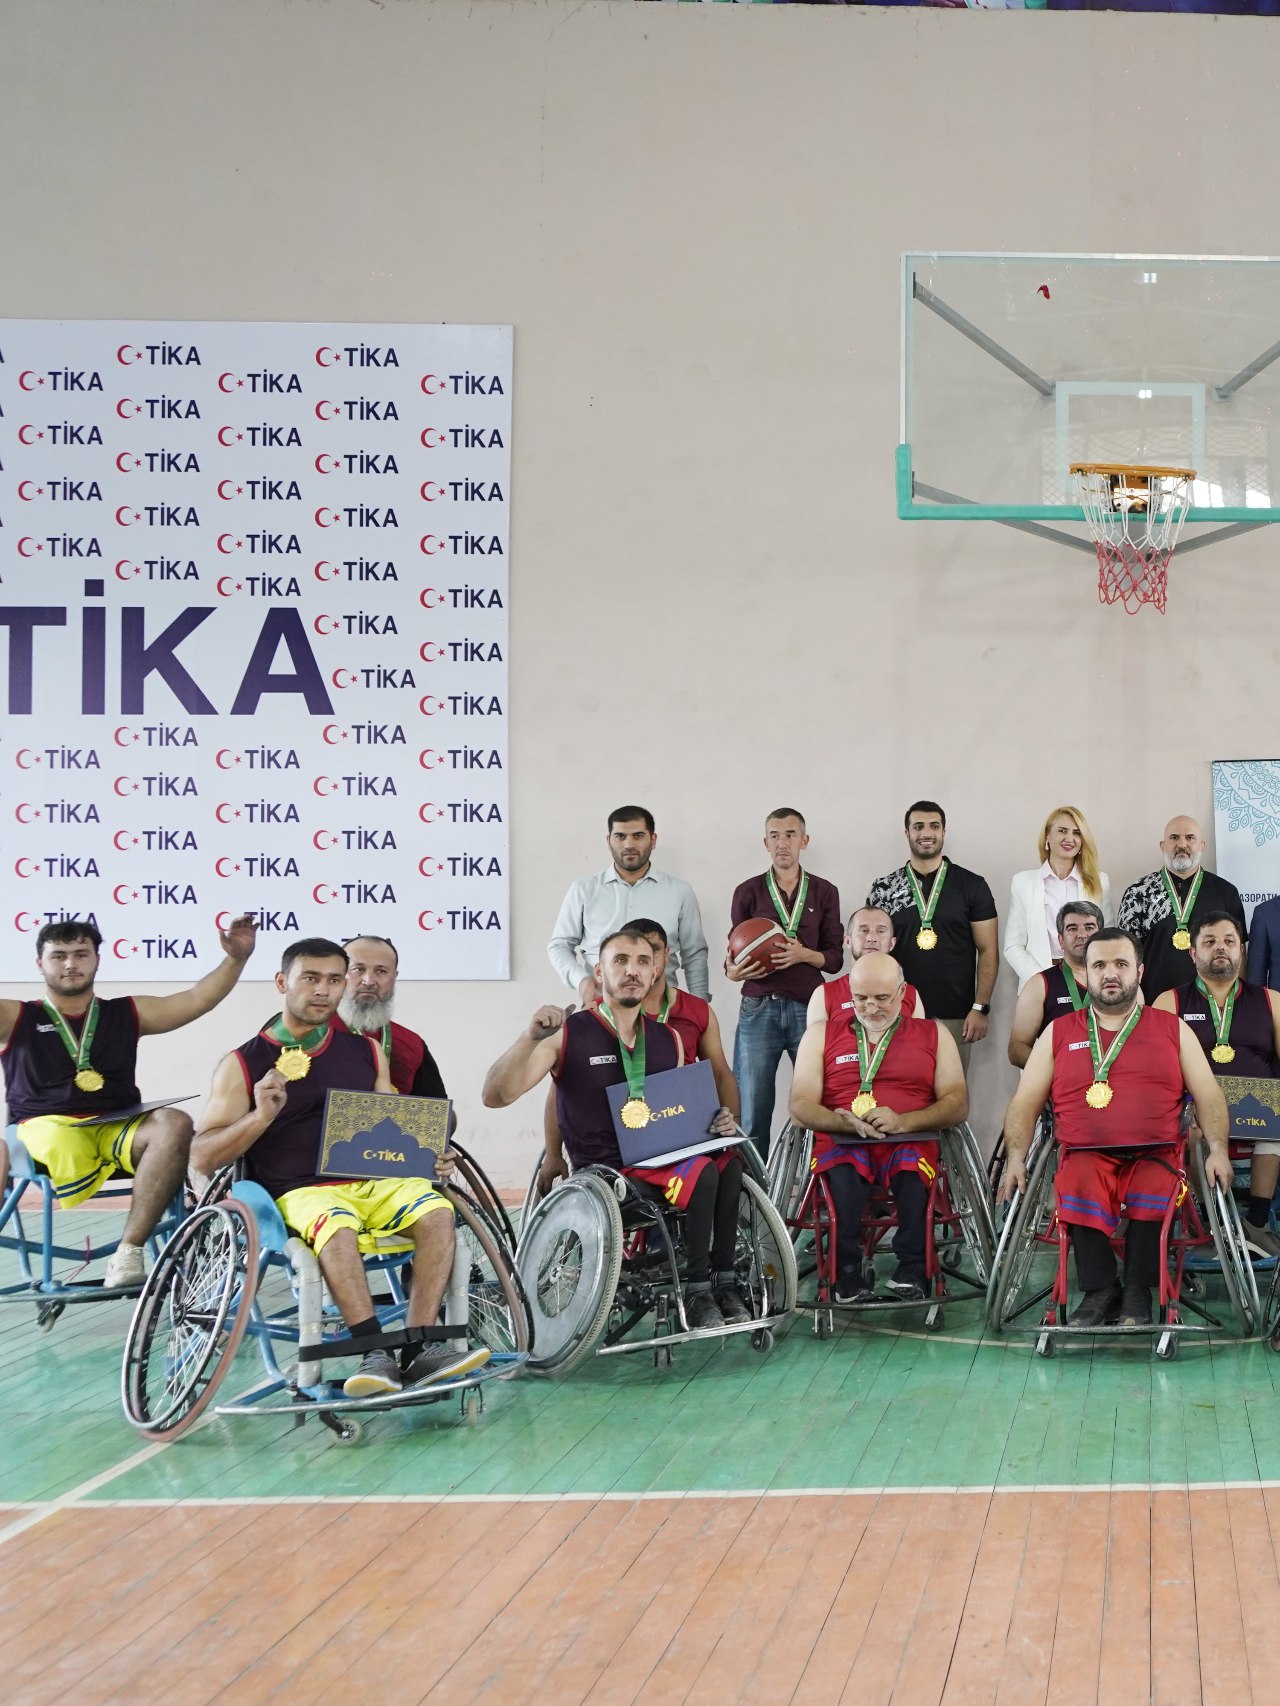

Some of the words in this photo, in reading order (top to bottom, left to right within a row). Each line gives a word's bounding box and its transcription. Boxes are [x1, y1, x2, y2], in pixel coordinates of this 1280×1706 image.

[145, 340, 202, 366] TİKA
[343, 342, 400, 368] TİKA
[47, 366, 104, 392] TİKA
[246, 368, 303, 394] TİKA
[448, 370, 505, 395] TİKA
[144, 394, 201, 420] TİKA
[343, 396, 400, 421] TİKA
[47, 420, 104, 446] TİKA
[246, 422, 303, 447] TİKA
[448, 423, 505, 449] TİKA
[144, 448, 201, 473] TİKA
[342, 449, 399, 475] TİKA
[46, 476, 103, 502] TİKA
[245, 475, 302, 501] TİKA
[447, 477, 504, 502] TİKA
[143, 501, 200, 527] TİKA
[342, 503, 399, 528] TİKA
[46, 532, 103, 558] TİKA
[245, 529, 302, 554] TİKA
[447, 530, 504, 555] TİKA
[143, 555, 200, 581] TİKA
[342, 556, 399, 582] TİKA
[245, 572, 302, 597] TİKA
[447, 583, 504, 609] TİKA
[342, 610, 399, 635] TİKA
[0, 578, 336, 716] TİKA
[447, 637, 504, 662] TİKA
[360, 664, 417, 689] TİKA
[446, 691, 503, 716] TİKA
[142, 722, 199, 747] TİKA
[350, 720, 407, 745] TİKA
[44, 744, 101, 769] TİKA
[244, 744, 301, 769] TİKA
[446, 744, 503, 769] TİKA
[142, 771, 199, 797] TİKA
[341, 771, 398, 796] TİKA
[44, 799, 101, 824] TİKA
[244, 798, 301, 823] TİKA
[446, 798, 503, 823] TİKA
[141, 826, 198, 851] TİKA
[340, 825, 397, 850] TİKA
[43, 853, 100, 878] TİKA
[243, 852, 300, 877] TİKA
[445, 852, 502, 877] TİKA
[141, 880, 198, 905] TİKA
[340, 879, 397, 904] TİKA
[445, 905, 502, 931] TİKA
[141, 934, 198, 959] TİKA
[661, 1105, 686, 1118] TİKA
[1247, 1117, 1266, 1126] TİKA
[378, 1149, 405, 1162] TİKA
